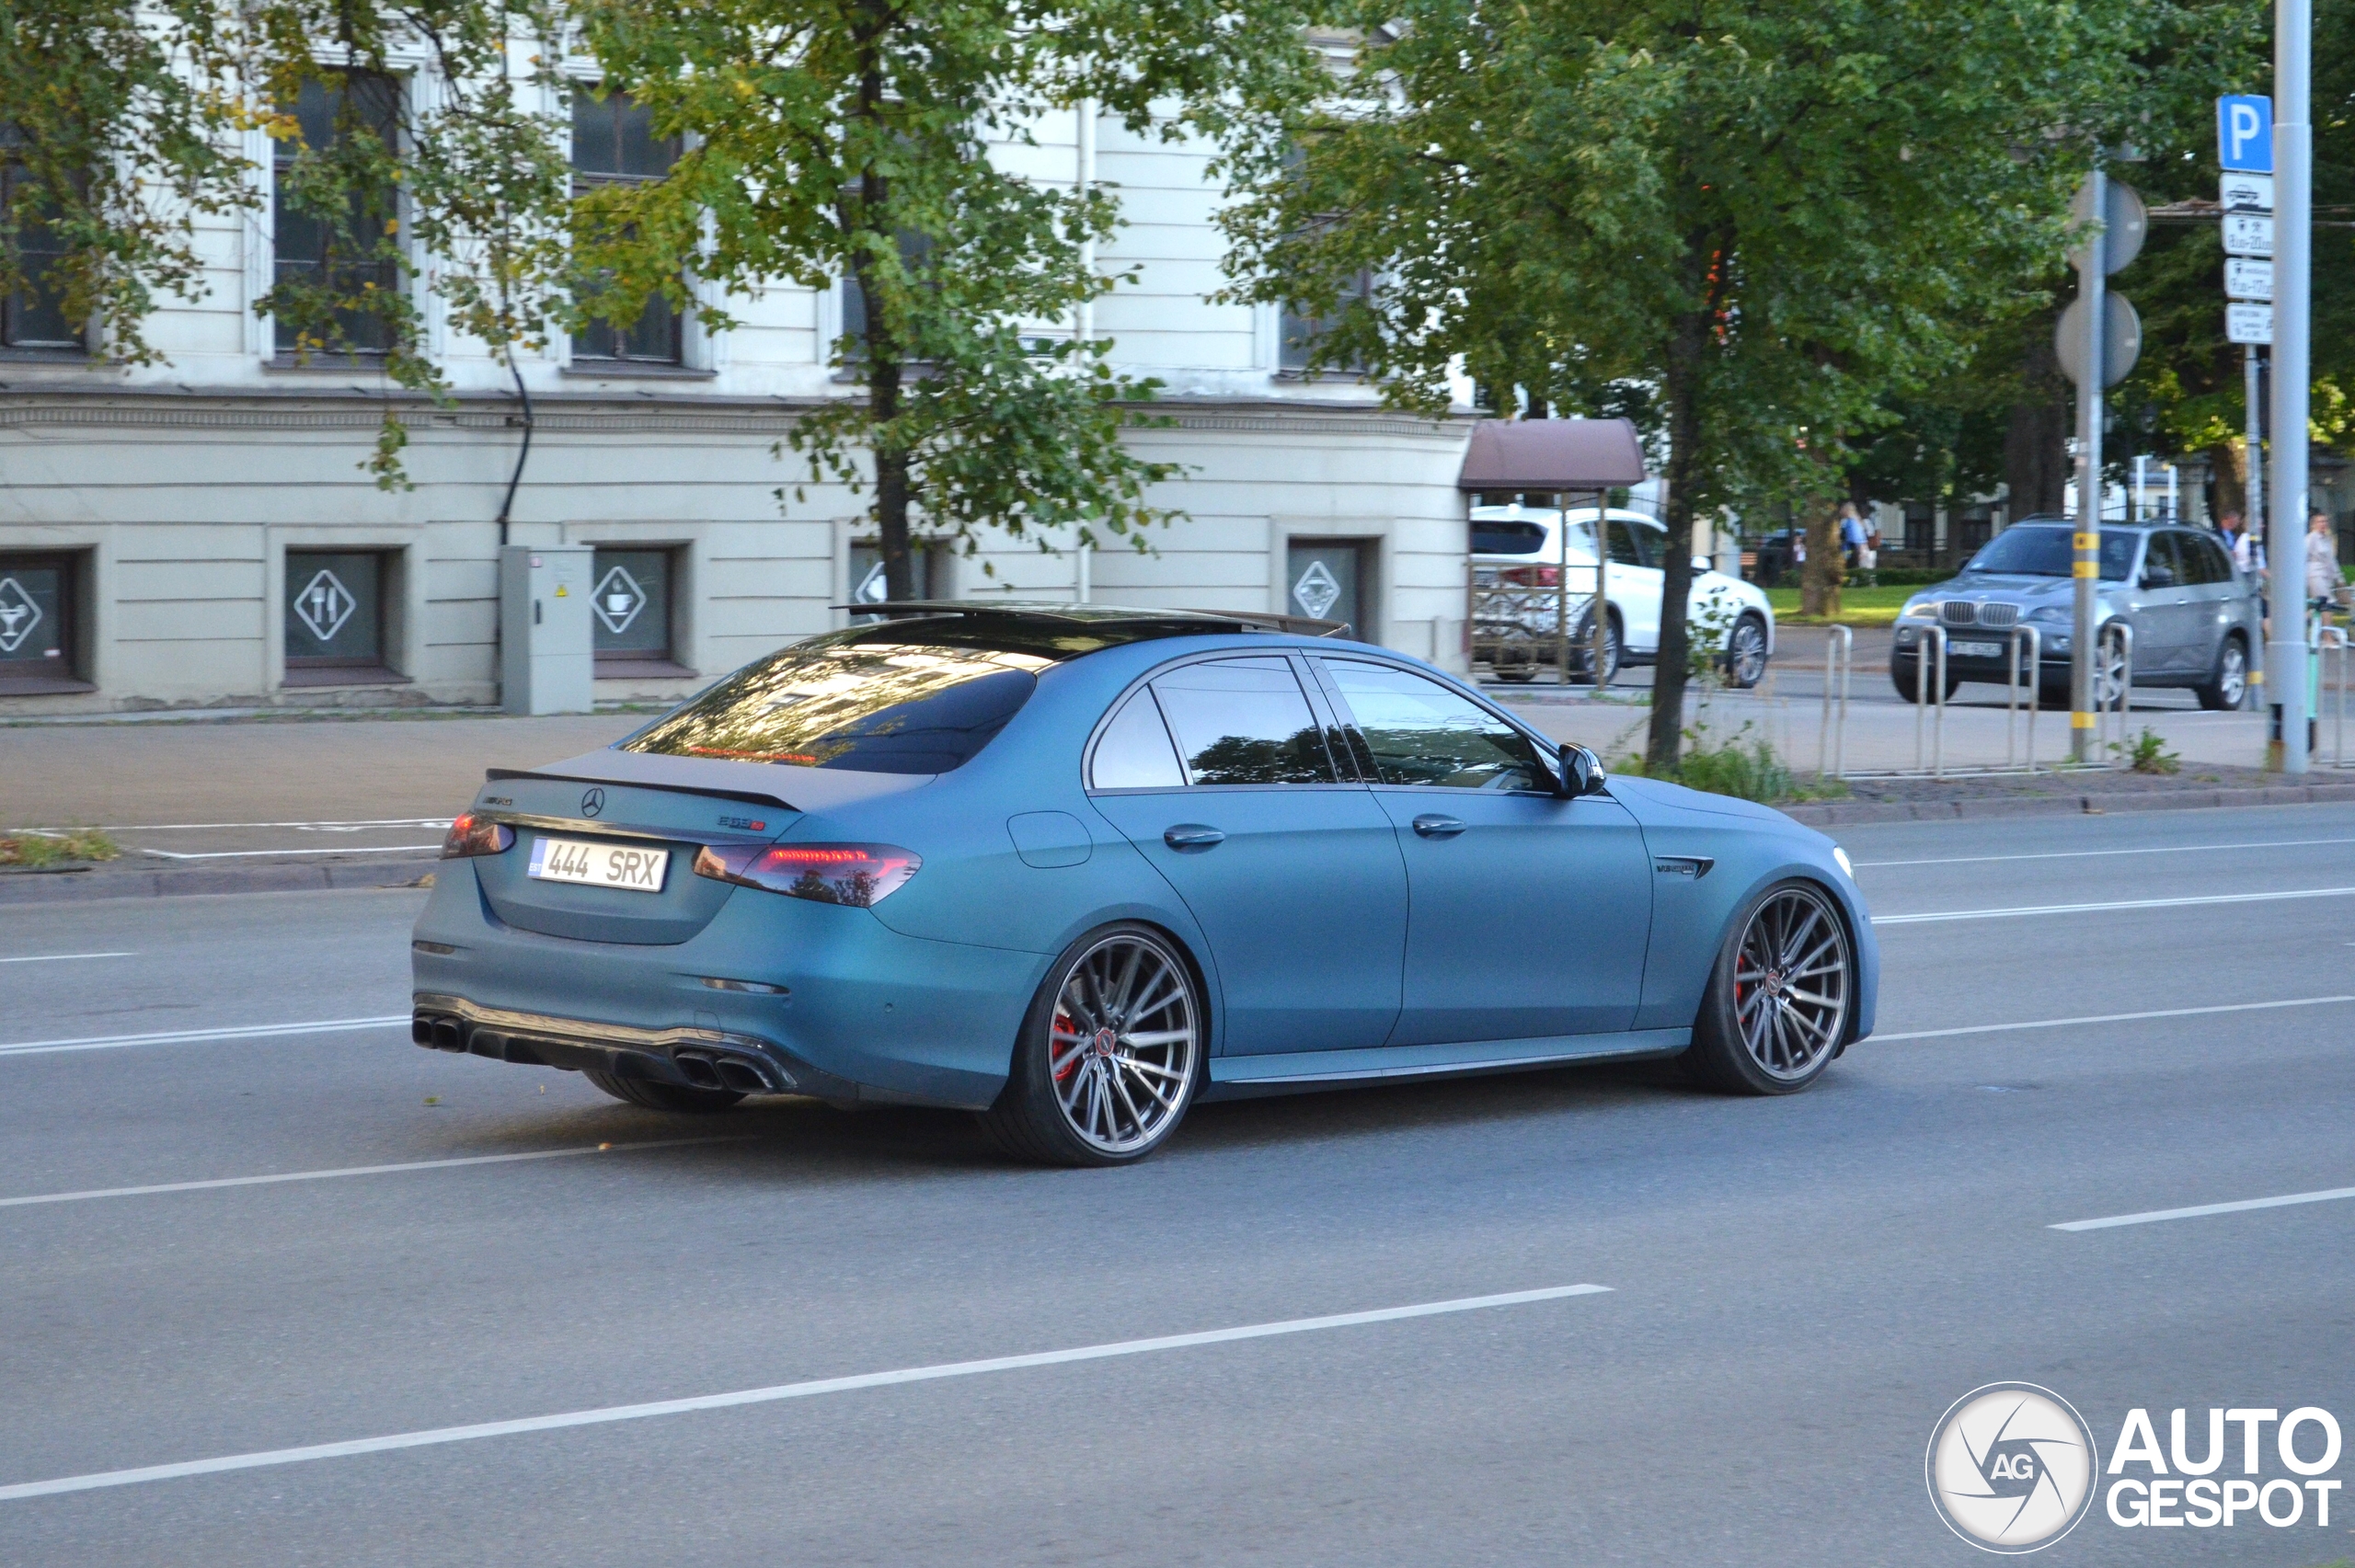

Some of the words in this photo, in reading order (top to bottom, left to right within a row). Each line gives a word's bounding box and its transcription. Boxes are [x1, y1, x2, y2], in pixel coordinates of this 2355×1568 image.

[2231, 103, 2261, 160] P
[528, 862, 542, 872] EST
[547, 844, 591, 878] 444
[605, 850, 660, 886] SRX
